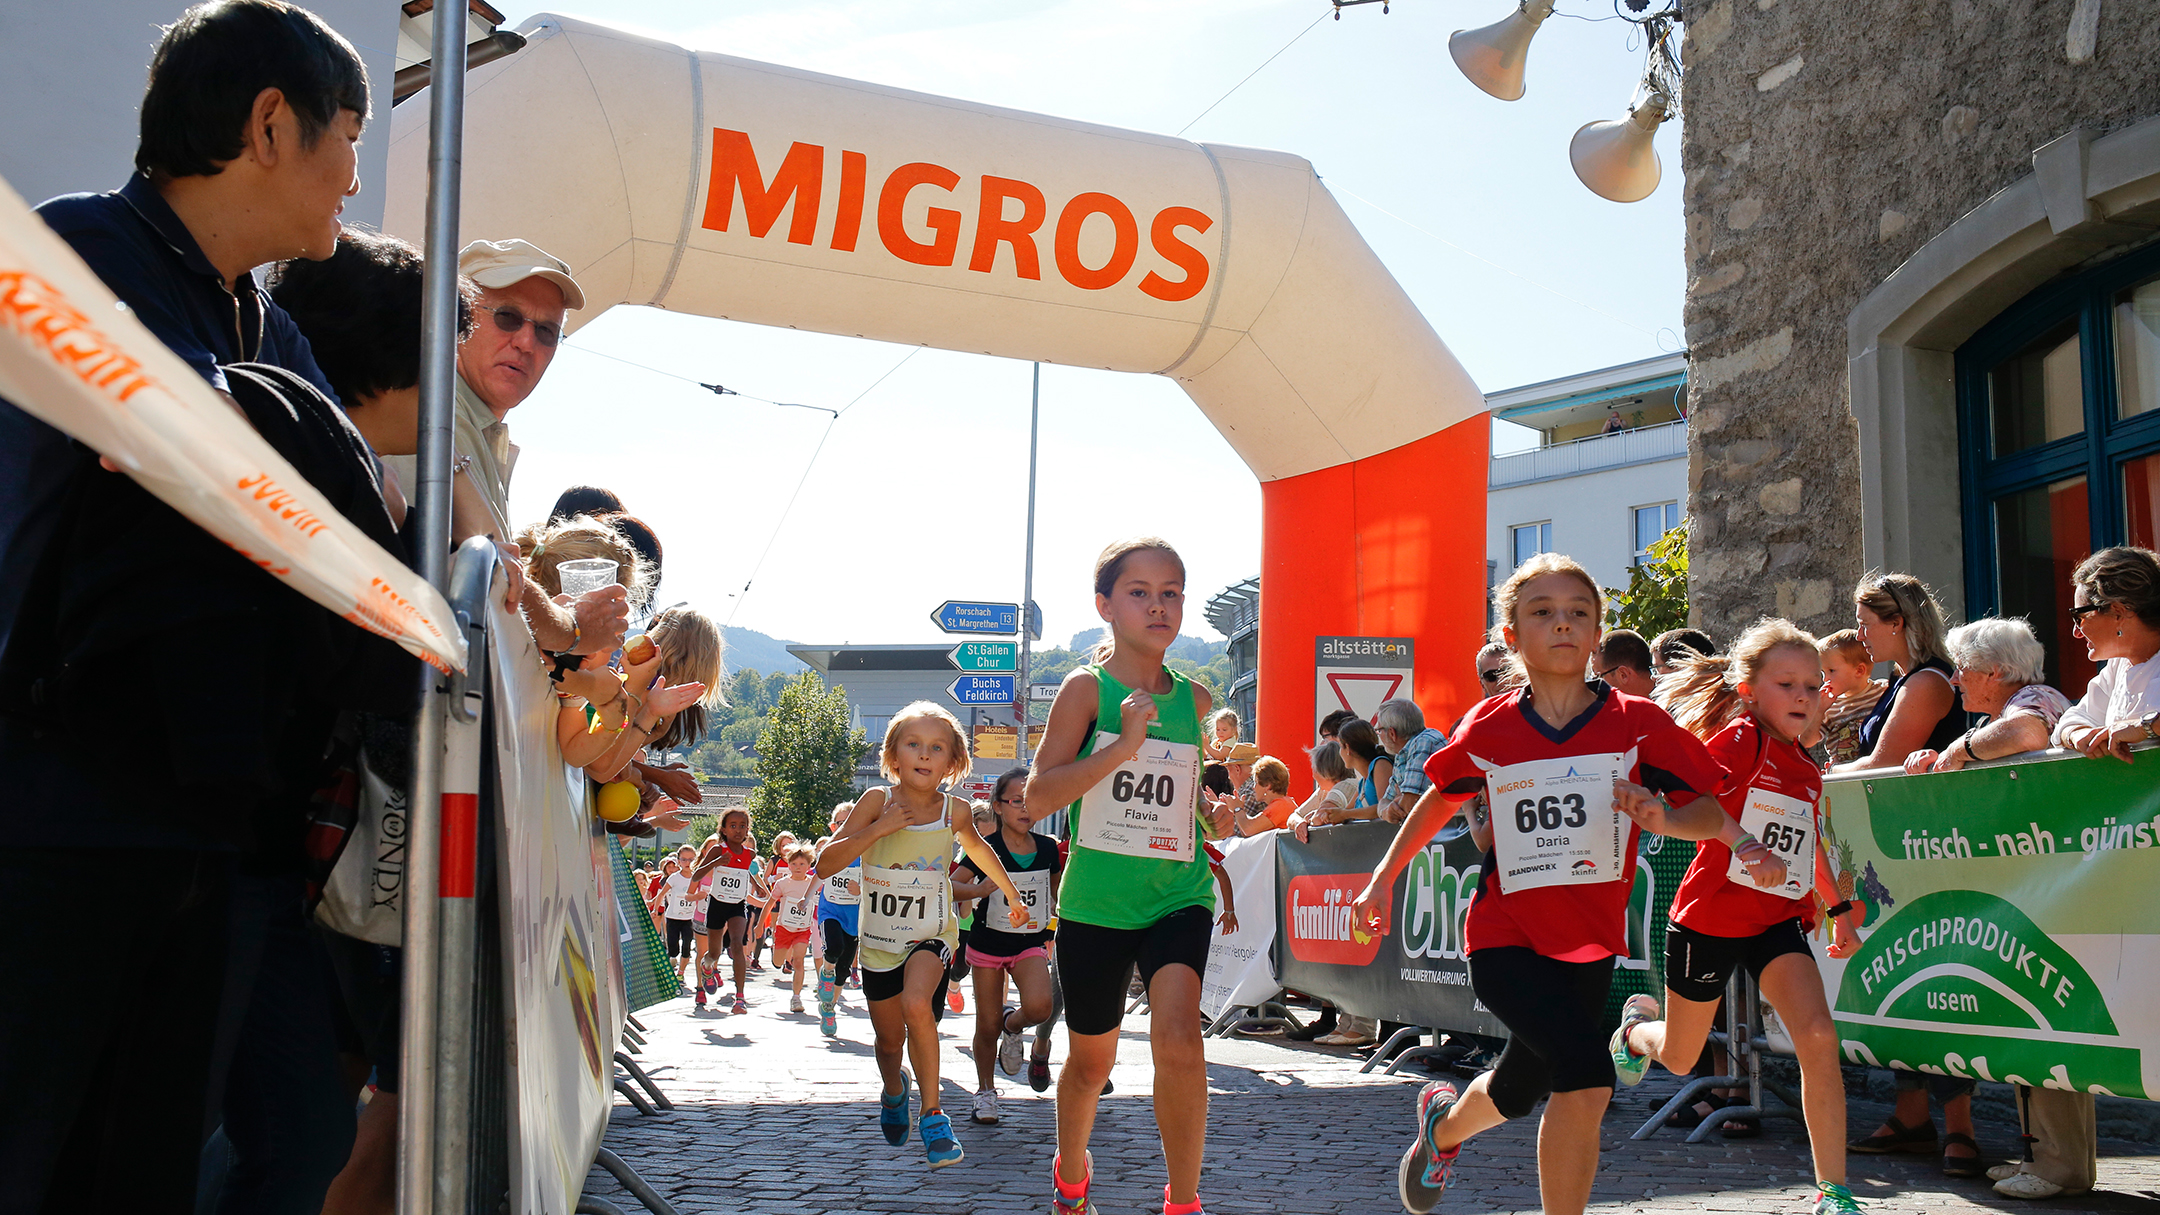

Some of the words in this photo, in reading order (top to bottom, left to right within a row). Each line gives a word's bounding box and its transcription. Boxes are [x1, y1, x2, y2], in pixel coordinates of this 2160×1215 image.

[701, 127, 1214, 302] MIGROS
[955, 606, 992, 616] Rorschach
[947, 618, 957, 628] St.
[960, 618, 999, 629] Margrethen
[1003, 615, 1012, 623] 13
[977, 657, 1000, 667] Chur
[972, 678, 1001, 688] Buchs
[965, 690, 1008, 700] Feldkirch
[985, 726, 1008, 734] Hotels
[1111, 770, 1174, 807] 640
[1497, 779, 1535, 795] MIGROS
[1124, 809, 1158, 821] Flavia
[1515, 793, 1587, 833] 663
[1752, 802, 1786, 816] MIGROS
[1126, 822, 1147, 830] Mädchen
[1536, 835, 1570, 848] Daria
[1762, 822, 1806, 855] 657
[1902, 828, 1973, 860] frisch
[1994, 822, 2055, 857] nah
[1518, 853, 1538, 861] Piccolo
[1538, 851, 1563, 859] Mädchen
[1571, 868, 1597, 876] skinfit
[720, 876, 741, 889] 630
[864, 875, 891, 887] MIGROS
[869, 890, 926, 920] 1071
[1292, 888, 1353, 941] familia
[1860, 916, 2075, 1008] FRISCHPRODUKTE
[1400, 968, 1467, 986] VOLLWERTNAHRUNG
[1927, 990, 1979, 1013] usem
